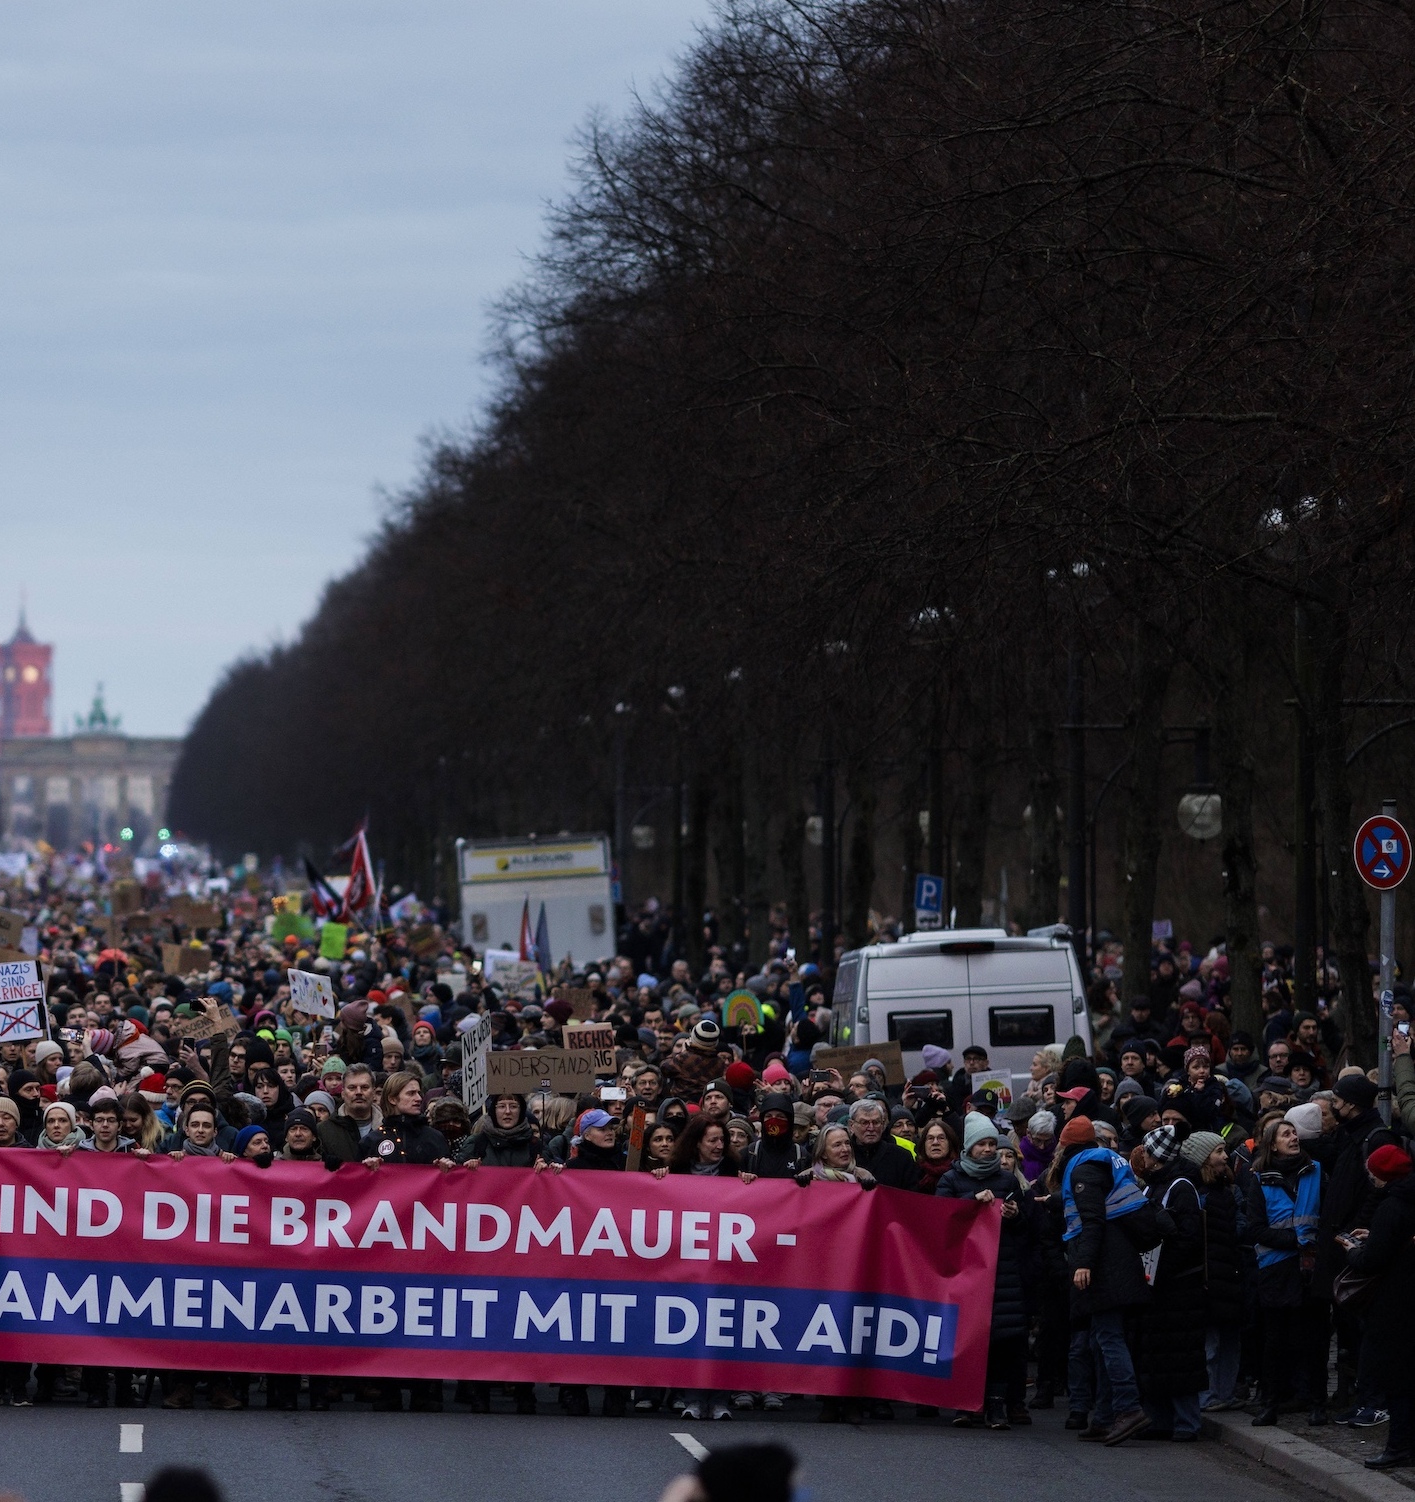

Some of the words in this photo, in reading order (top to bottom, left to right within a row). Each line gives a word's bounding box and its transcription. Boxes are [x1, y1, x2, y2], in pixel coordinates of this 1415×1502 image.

[921, 880, 937, 906] P
[1, 975, 26, 988] SIND
[464, 1029, 478, 1059] NIE
[568, 1030, 613, 1050] RECHTS
[464, 1057, 477, 1082] IST
[489, 1055, 592, 1078] WIDERSTAND!
[143, 1191, 250, 1245] DIE
[270, 1197, 758, 1263] BRANDMAUER
[513, 1290, 638, 1344] MIT
[654, 1295, 783, 1352] DER
[795, 1303, 945, 1365] AFD!
